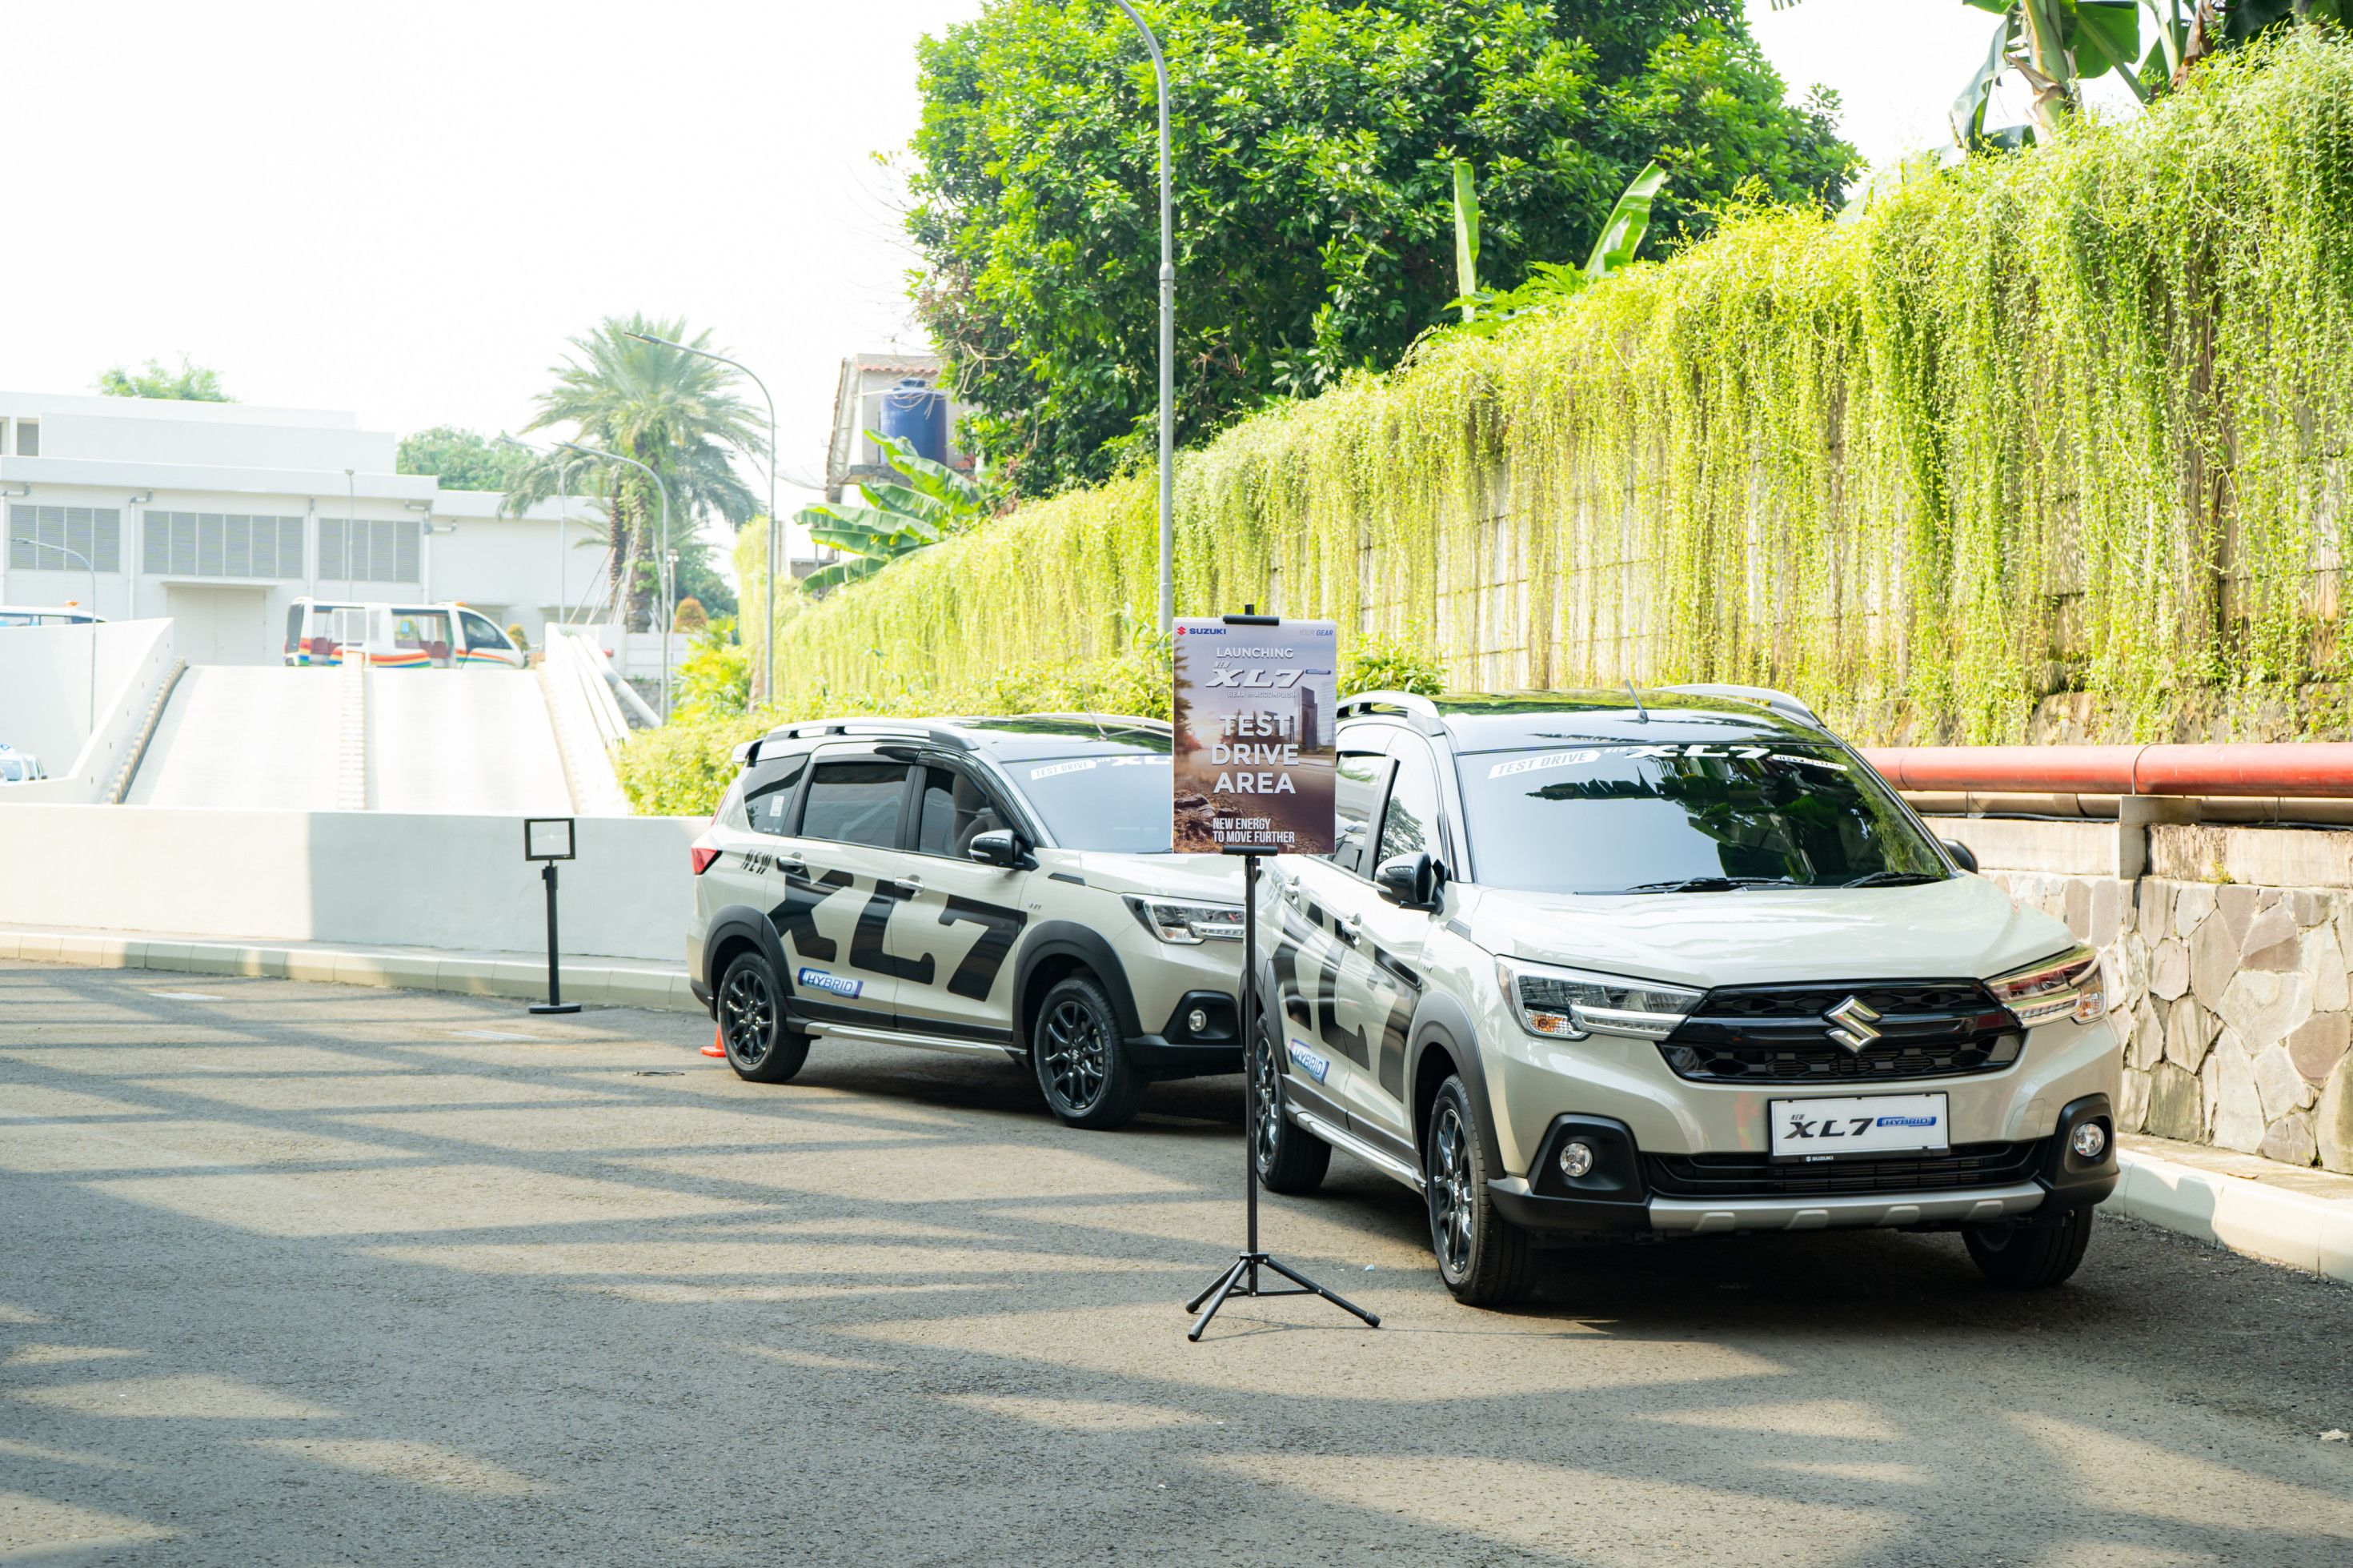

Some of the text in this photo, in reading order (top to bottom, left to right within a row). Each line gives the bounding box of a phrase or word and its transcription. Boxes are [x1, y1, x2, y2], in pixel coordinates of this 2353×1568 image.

[1216, 647, 1293, 659] LAUNCHING
[1205, 668, 1305, 688] XL7
[1255, 691, 1298, 699] ACCOMPLISH
[1220, 714, 1290, 736] TEST
[1211, 744, 1299, 766] DRIVE
[1624, 744, 1771, 759] XL7
[1036, 765, 1057, 777] TEST
[1497, 752, 1589, 776] TEST DRIVE
[1213, 772, 1297, 794] AREA
[1213, 817, 1271, 830] NEW ENERGY
[1213, 830, 1295, 843] TO MOVE FURTHER
[740, 848, 773, 875] NEW
[767, 856, 1028, 1003] XL7
[807, 973, 853, 992] HYBRID
[1293, 1047, 1324, 1076] HYBRID
[1783, 1117, 1929, 1139] XL7 HYBRID
